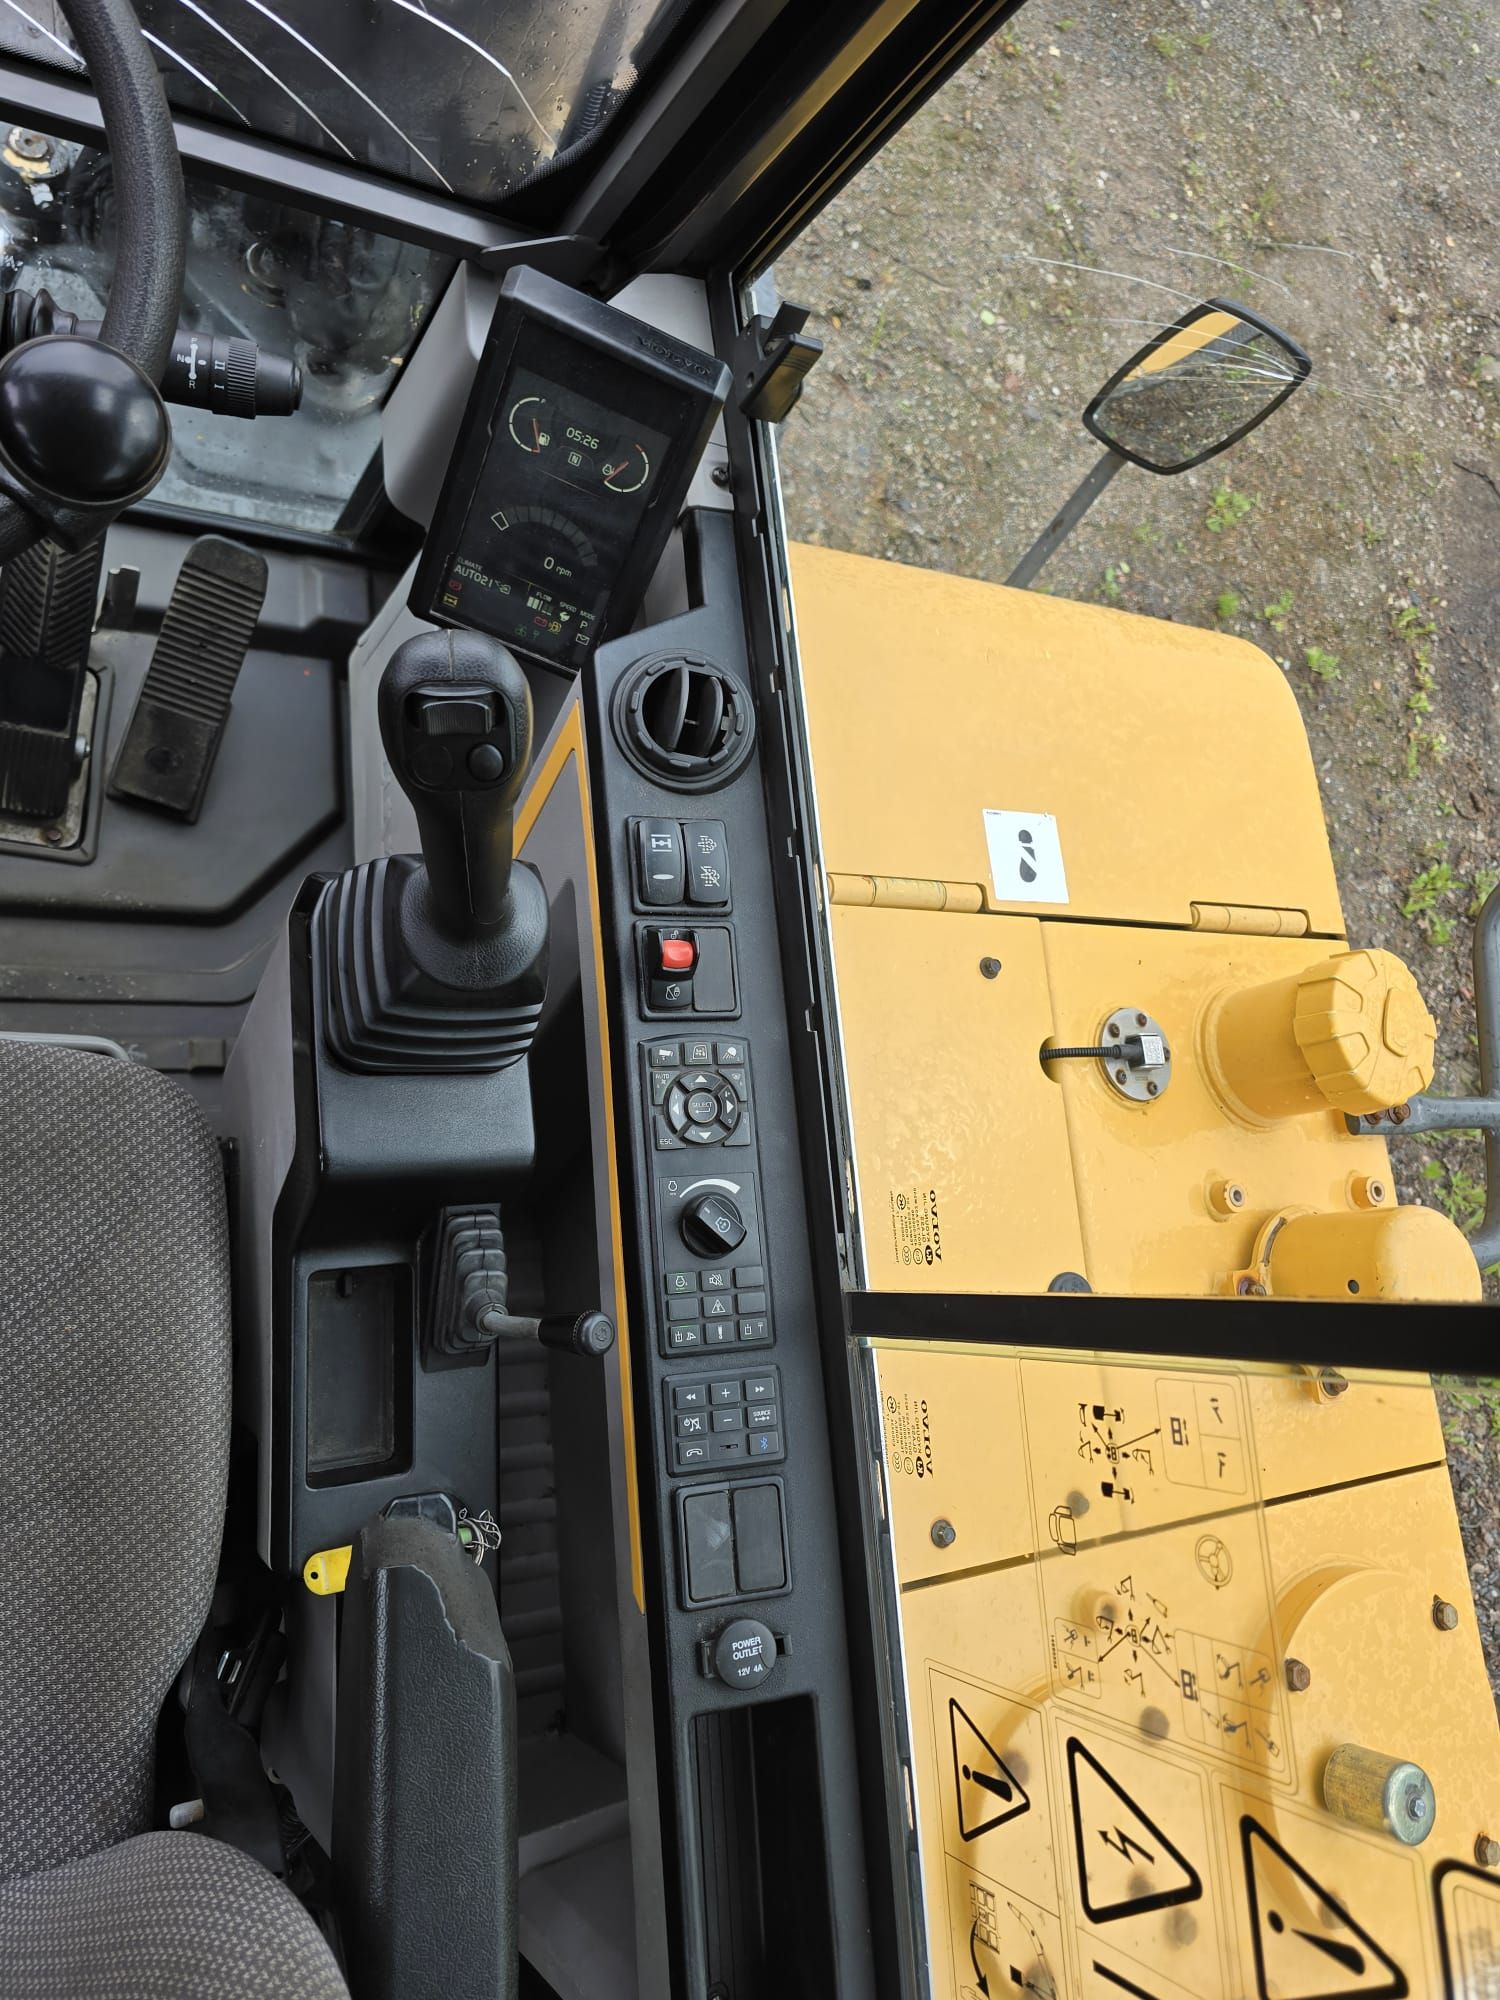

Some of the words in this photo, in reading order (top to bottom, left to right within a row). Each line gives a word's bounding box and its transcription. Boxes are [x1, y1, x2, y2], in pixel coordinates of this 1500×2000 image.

[177, 354, 185, 363] N
[188, 380, 196, 389] R
[566, 427, 600, 449] 05:26
[543, 556, 554, 570] 0
[555, 566, 572, 578] rpm
[536, 591, 552, 602] FLOW
[579, 620, 589, 630] P
[732, 1636, 762, 1651] POWER
[732, 1645, 763, 1661] OUTLET
[737, 1666, 751, 1677] 12V
[753, 1663, 764, 1673] 4A
